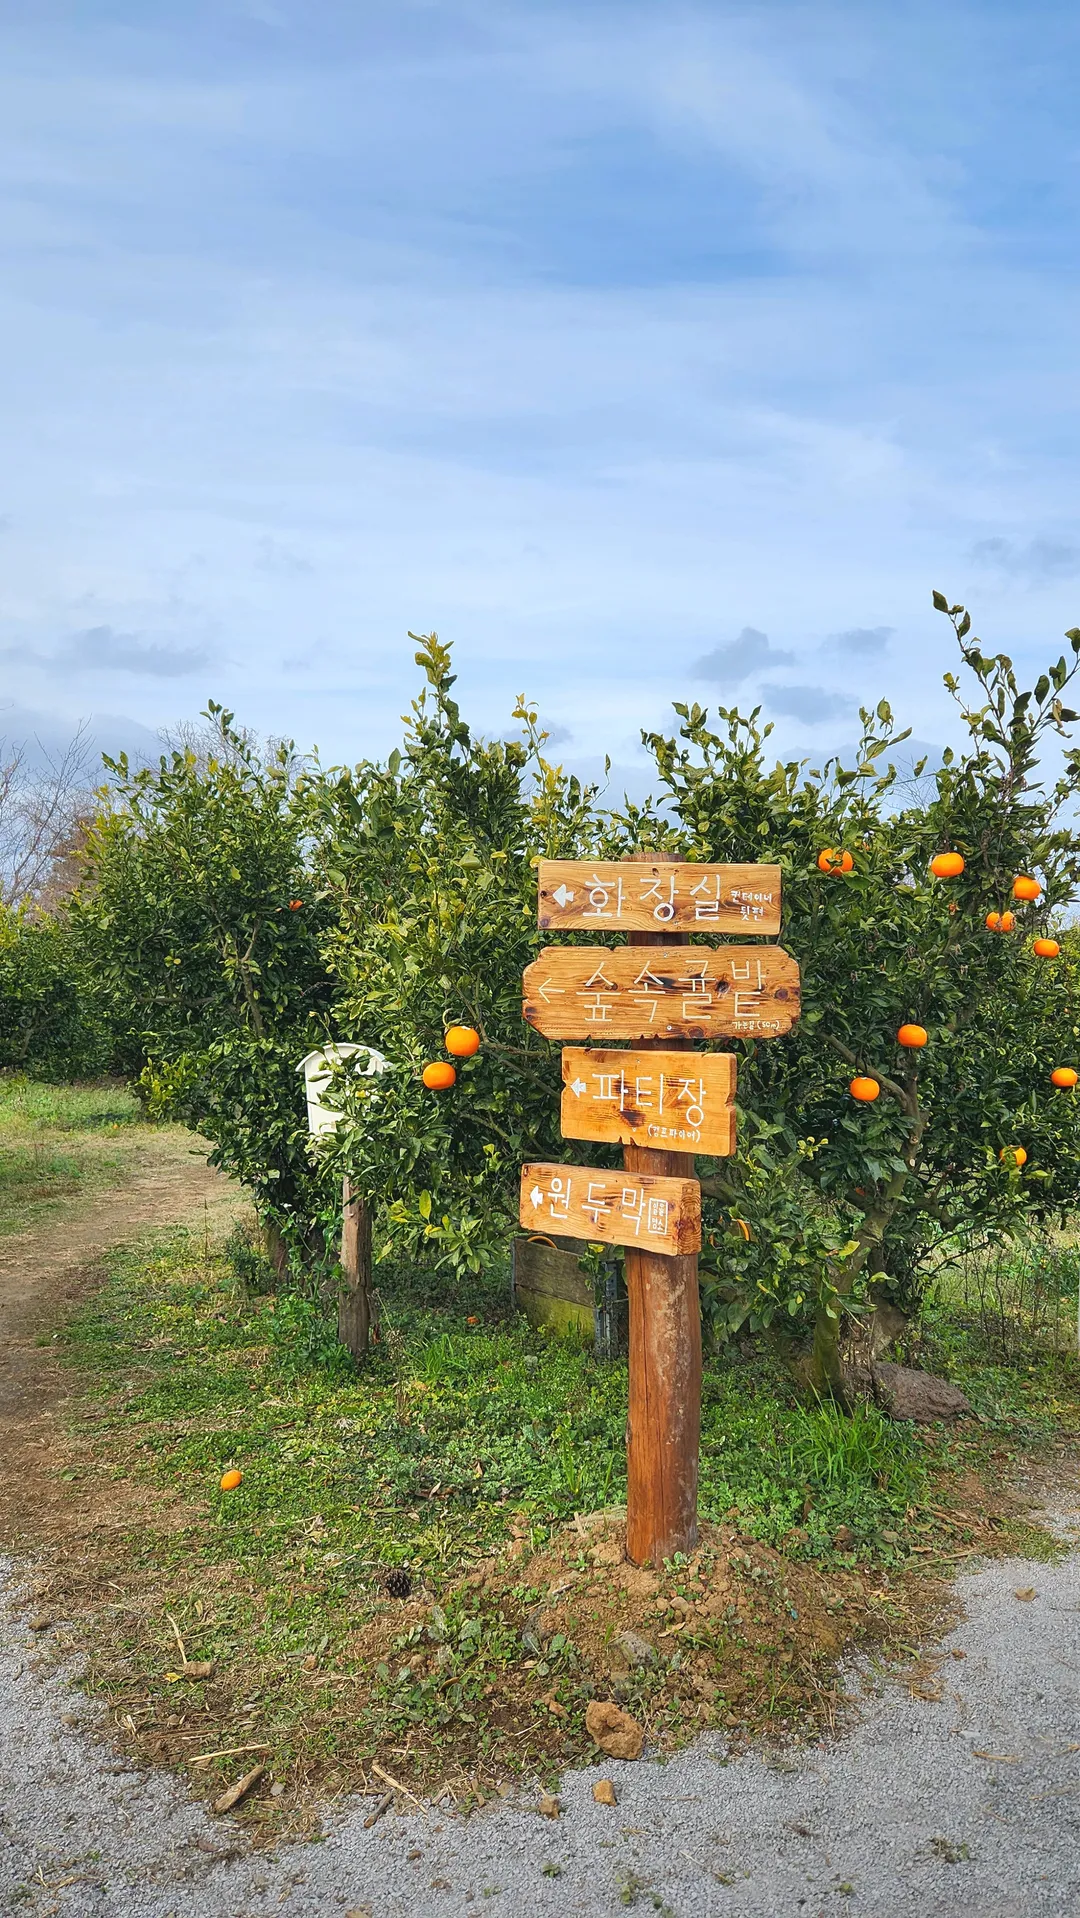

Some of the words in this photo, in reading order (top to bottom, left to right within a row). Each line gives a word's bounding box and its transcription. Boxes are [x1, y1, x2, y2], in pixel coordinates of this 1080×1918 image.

[582, 873, 722, 922] 화장실
[739, 905, 765, 922] 뒷편
[591, 1069, 707, 1127] 파티장
[547, 1177, 646, 1236] 원두막
